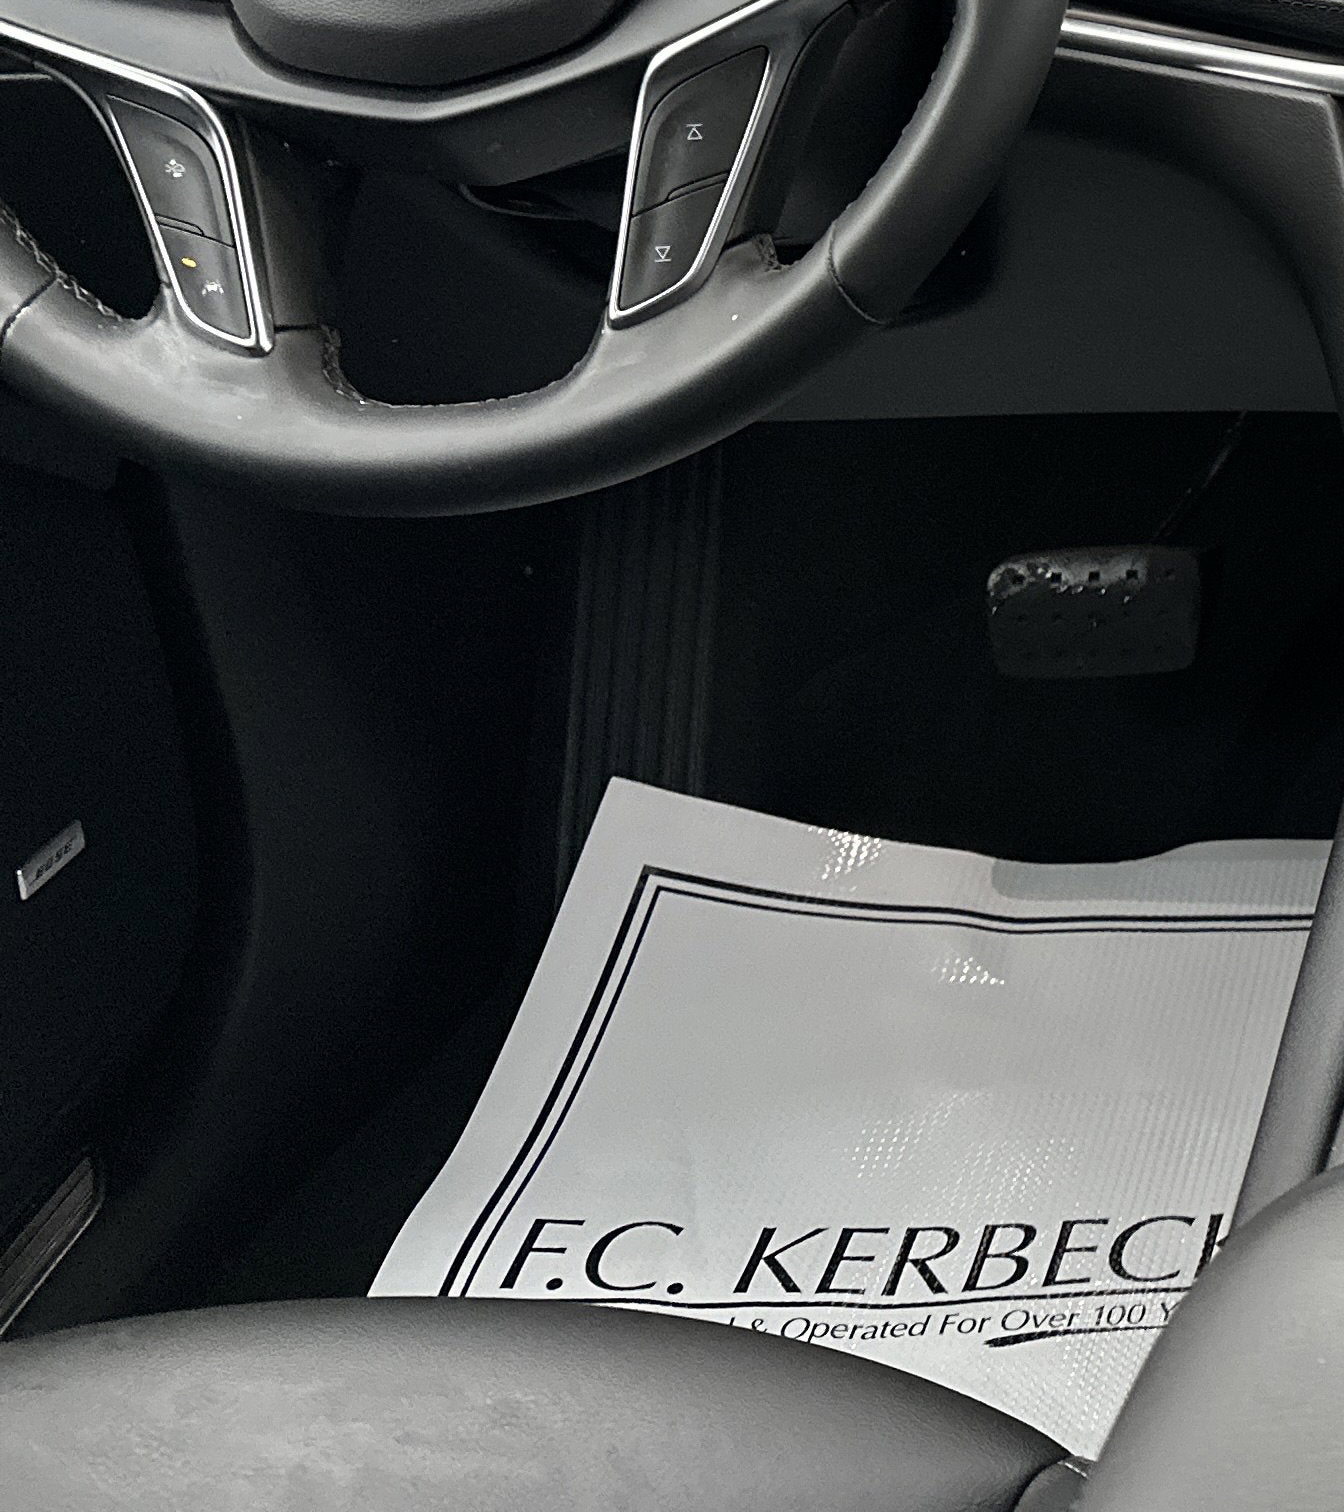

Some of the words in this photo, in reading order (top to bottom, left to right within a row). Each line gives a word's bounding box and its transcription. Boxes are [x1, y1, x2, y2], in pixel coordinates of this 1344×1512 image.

[499, 1217, 684, 1295] F.C.
[780, 1314, 928, 1343] Operated
[939, 1312, 990, 1335] For
[1001, 1309, 1082, 1332] Over
[1095, 1303, 1147, 1326] 100
